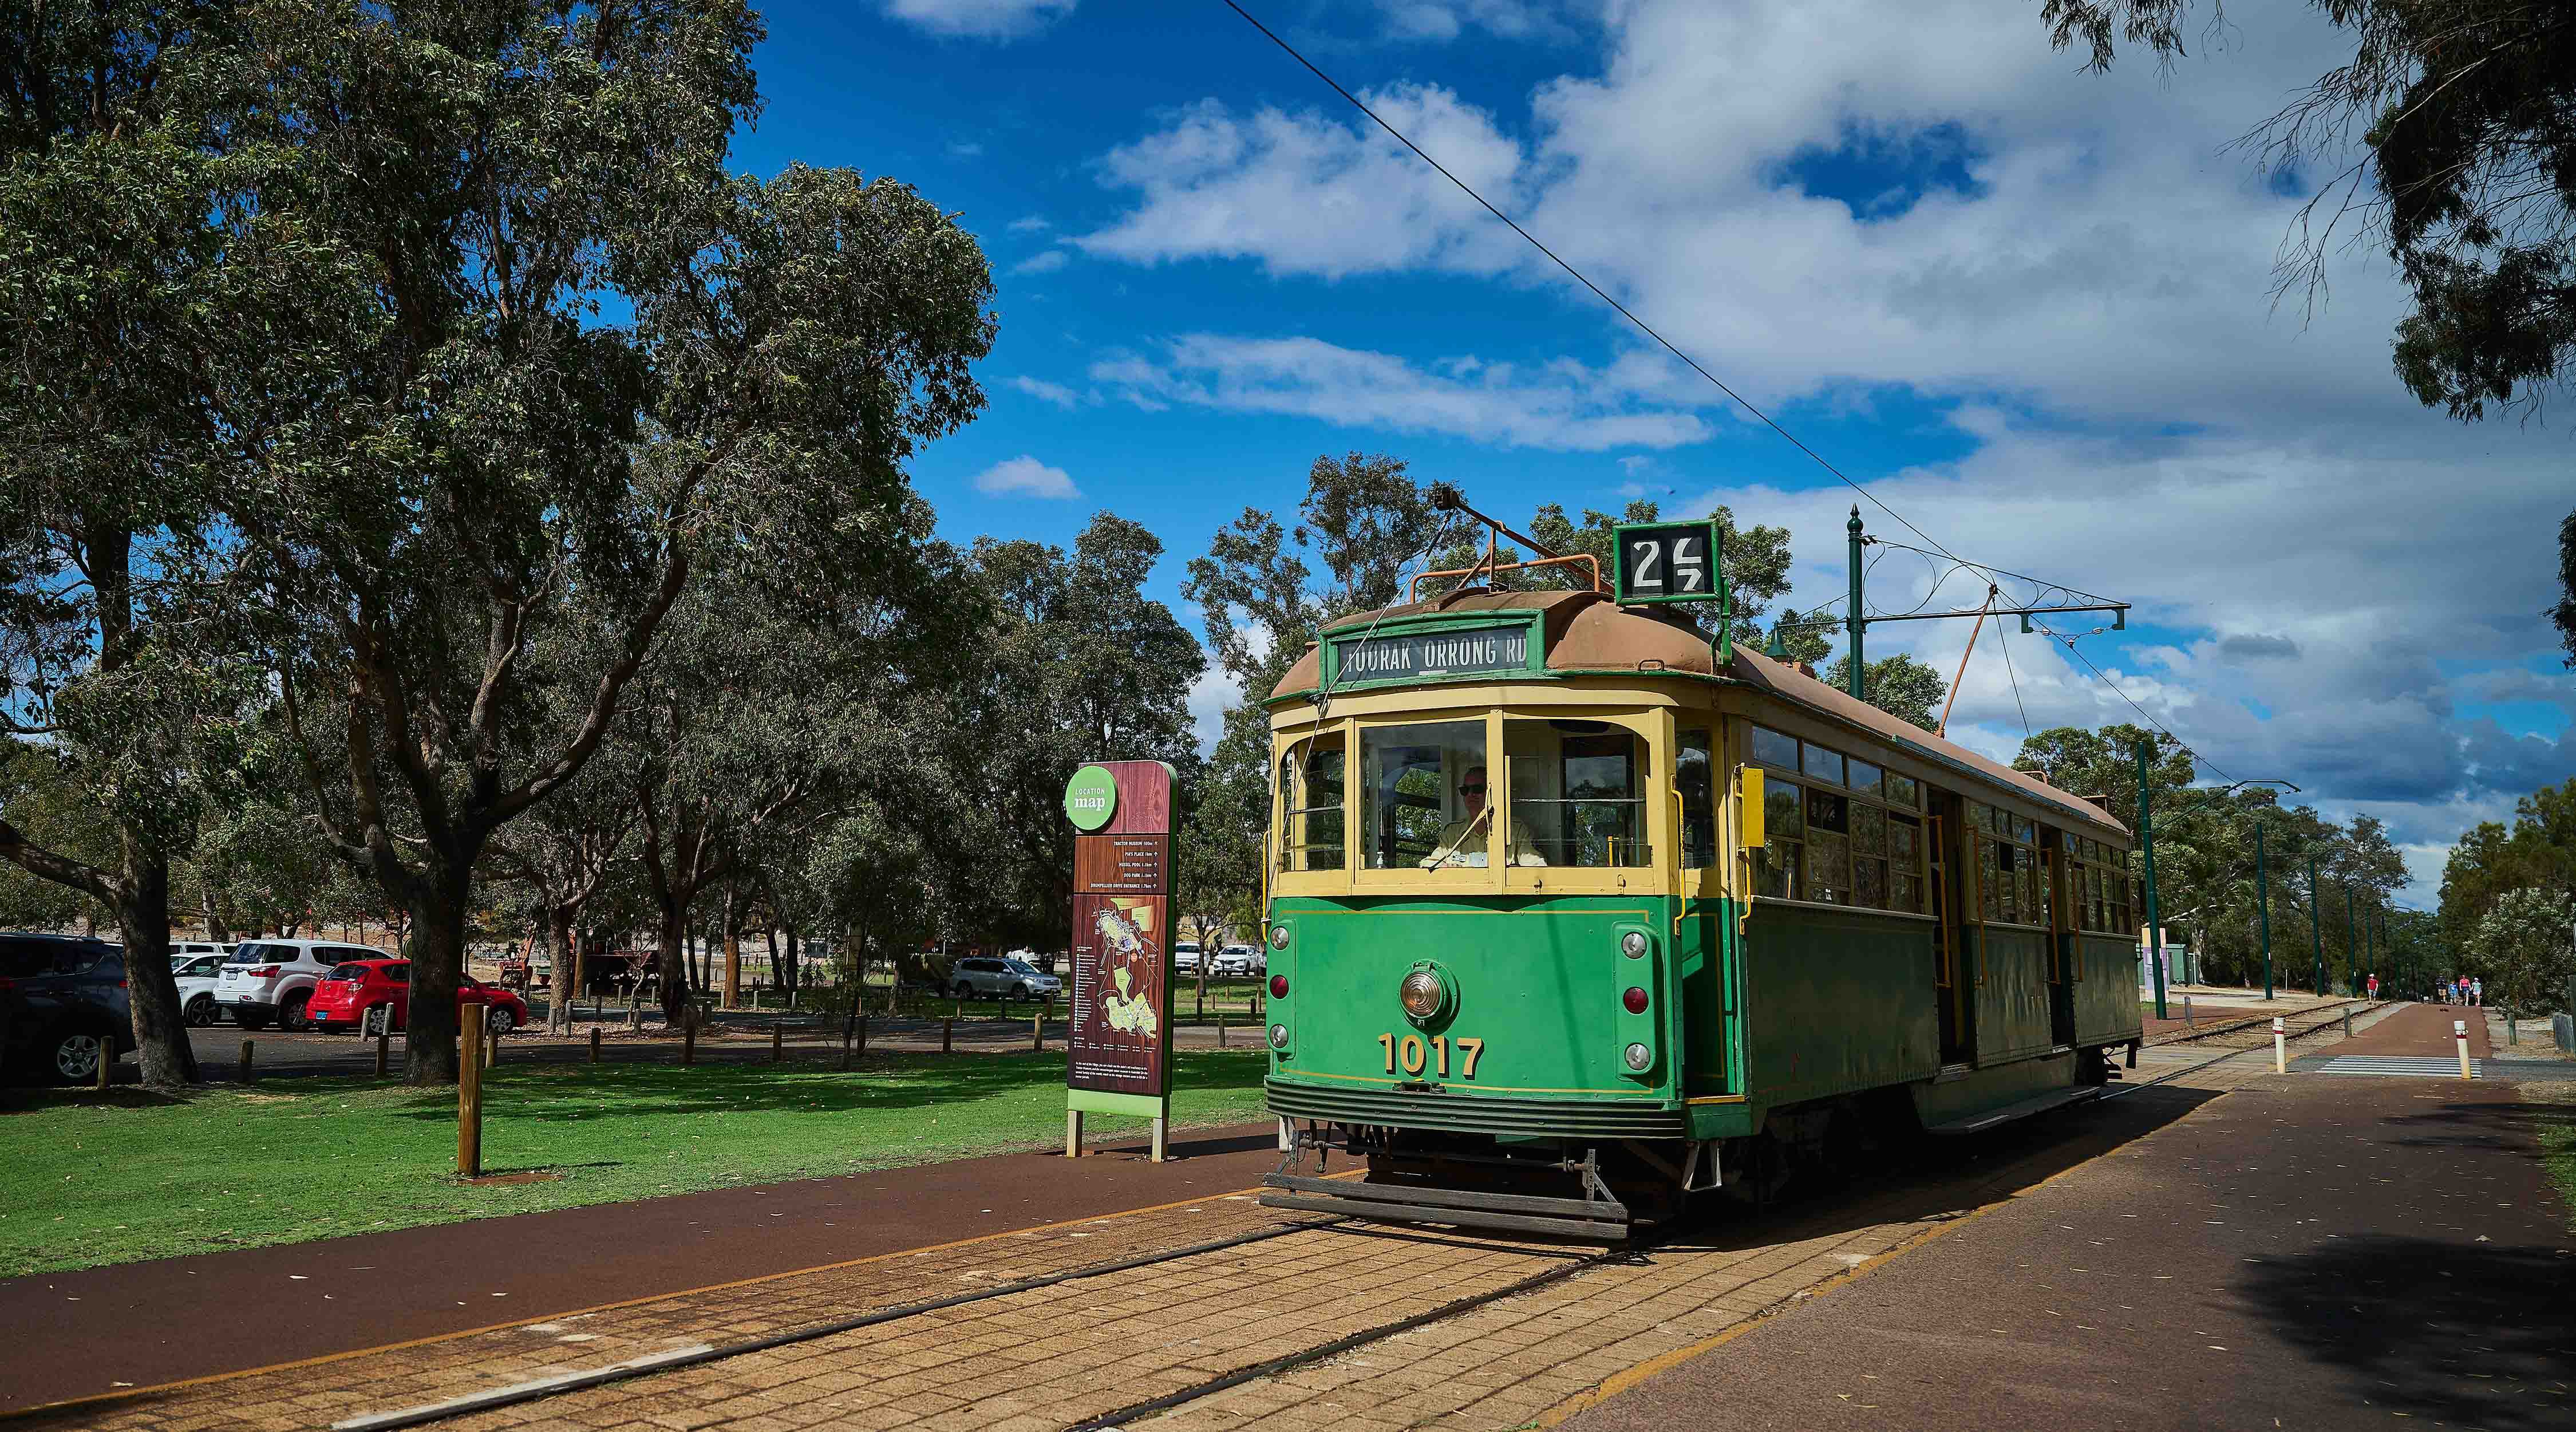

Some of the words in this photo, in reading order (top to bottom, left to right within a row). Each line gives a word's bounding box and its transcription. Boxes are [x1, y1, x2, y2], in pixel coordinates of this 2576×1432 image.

[1424, 636, 1497, 668] ORRONG
[1506, 635, 1527, 663] RD
[1075, 787, 1105, 795] LOCATION
[1074, 797, 1105, 811] map
[1378, 1032, 1485, 1081] 1017
